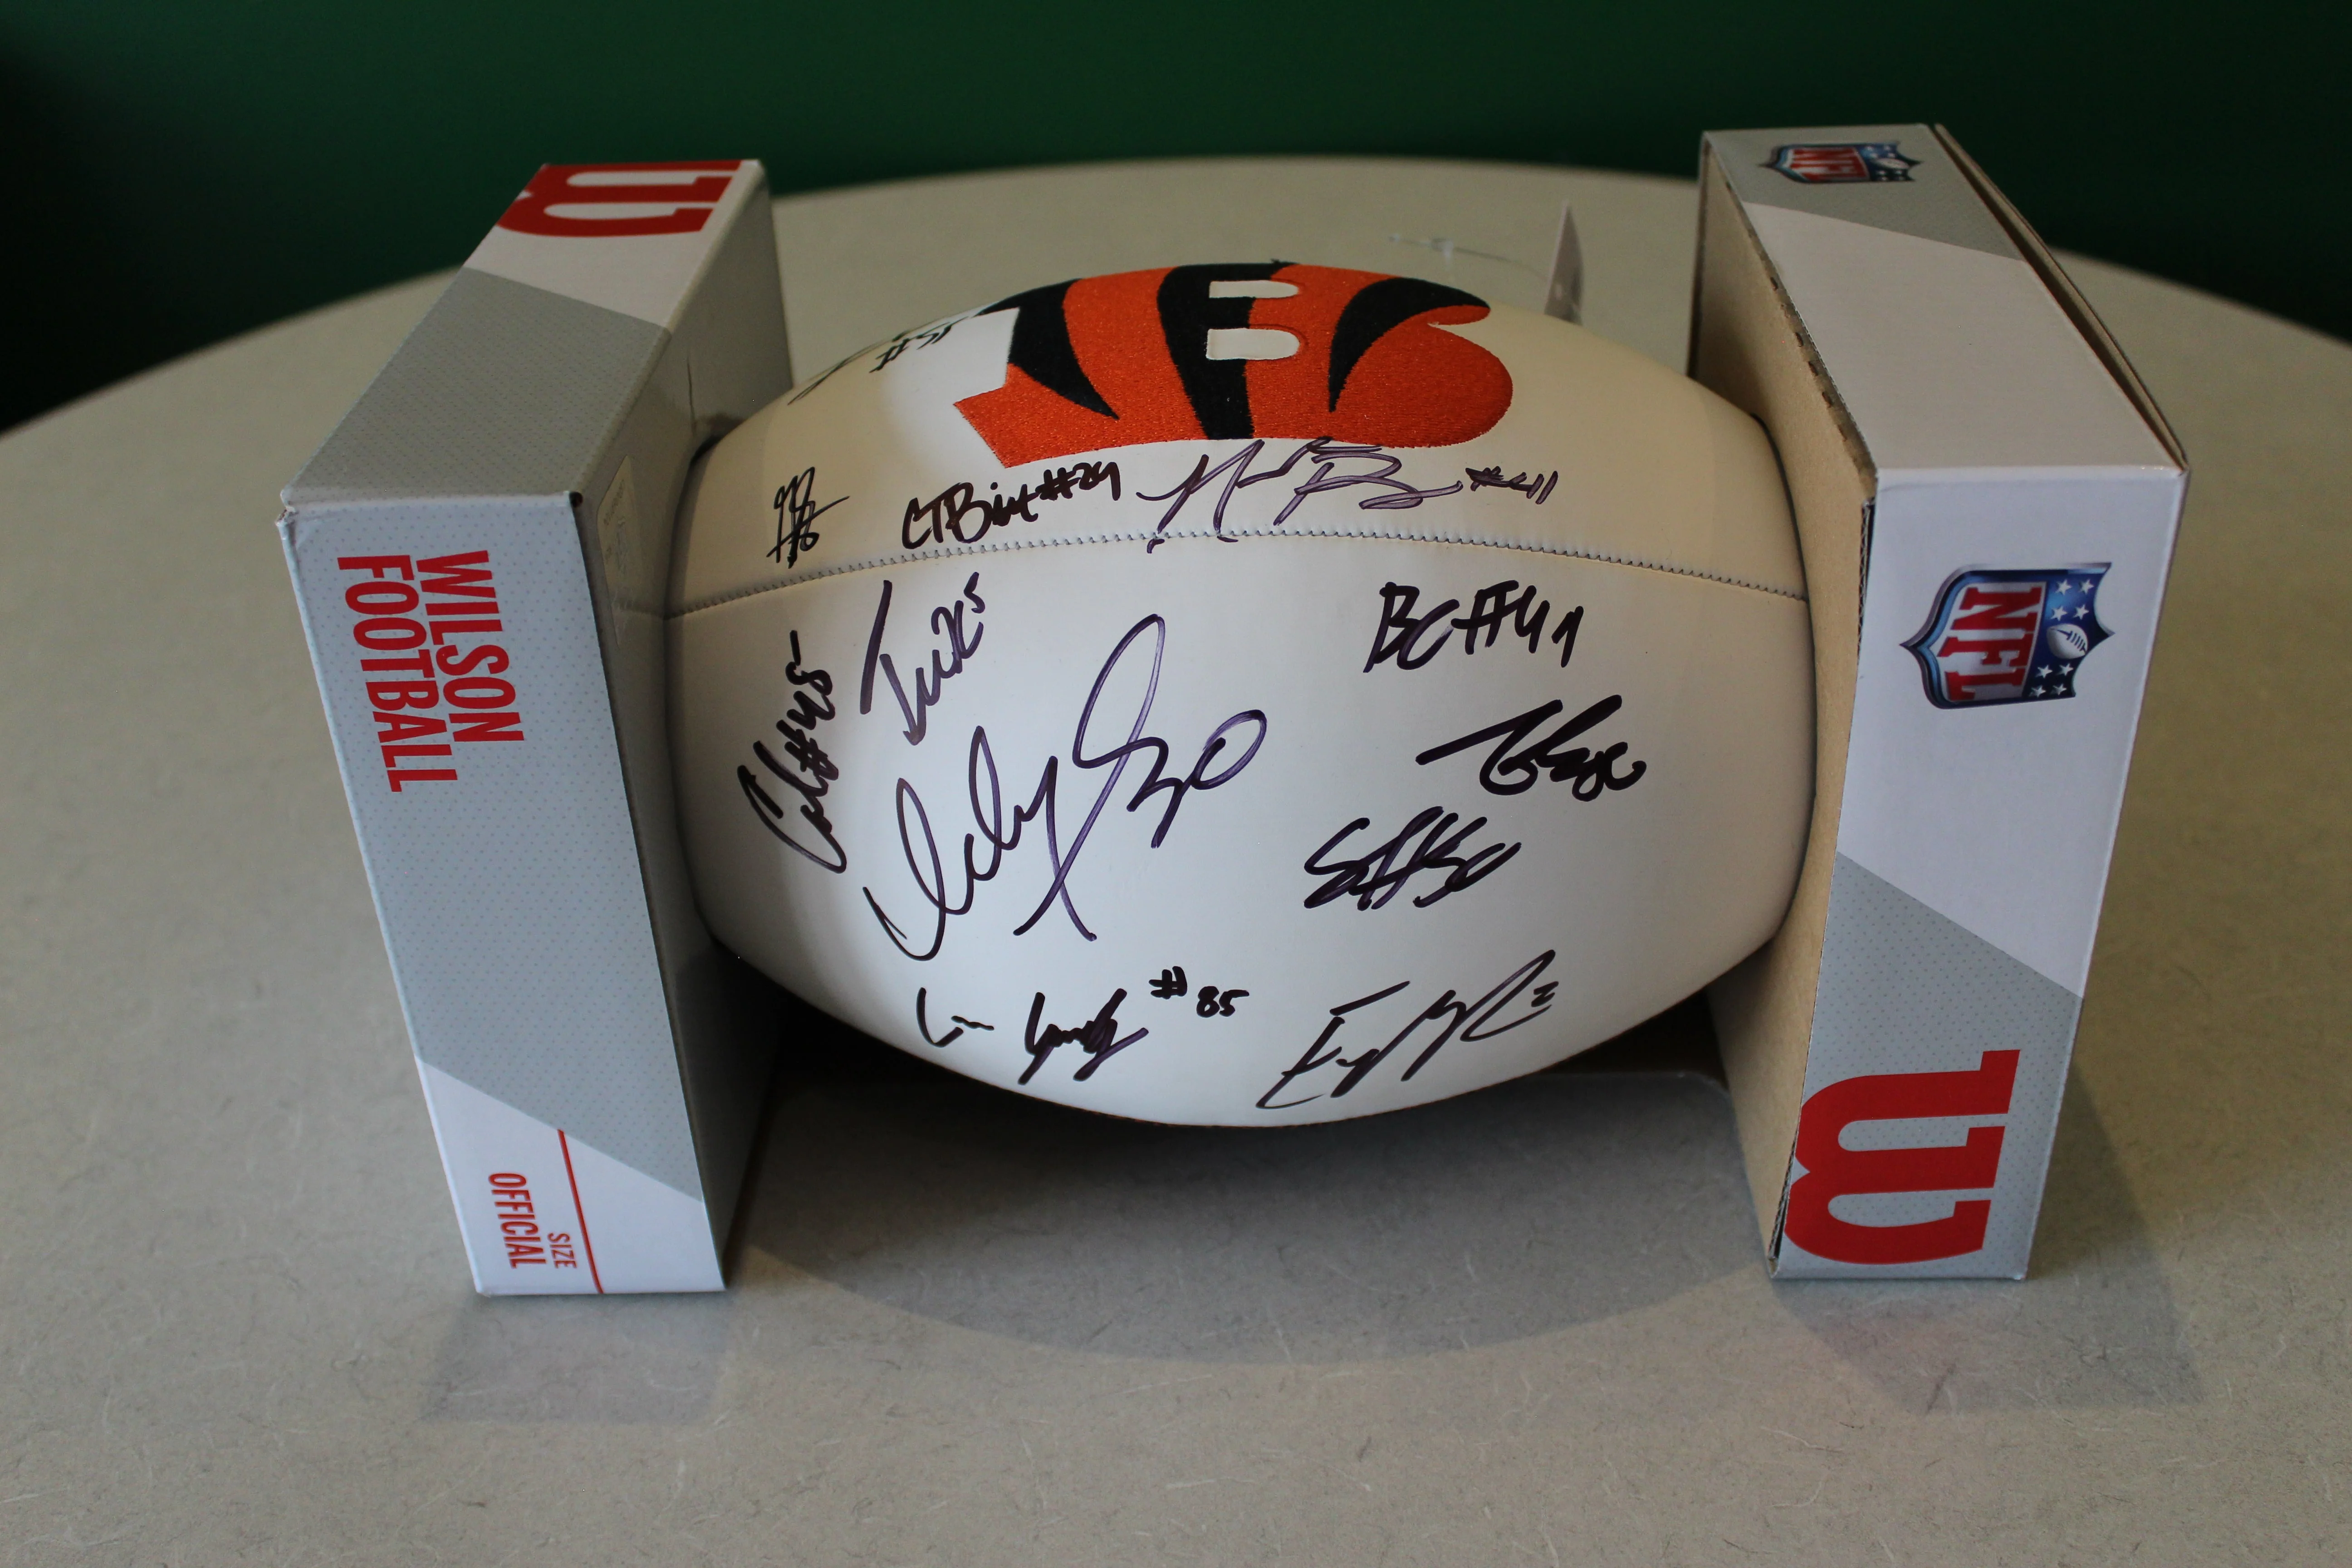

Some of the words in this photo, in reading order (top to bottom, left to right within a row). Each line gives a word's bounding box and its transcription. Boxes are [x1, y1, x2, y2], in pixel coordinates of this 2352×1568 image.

[1790, 146, 1869, 181] NFL
[337, 554, 458, 793] FOOTBALL
[416, 549, 524, 742] WILSON
[1936, 585, 2043, 701] NFL
[488, 1172, 547, 1269] OFFICIAL
[547, 1232, 578, 1269] SIZE
